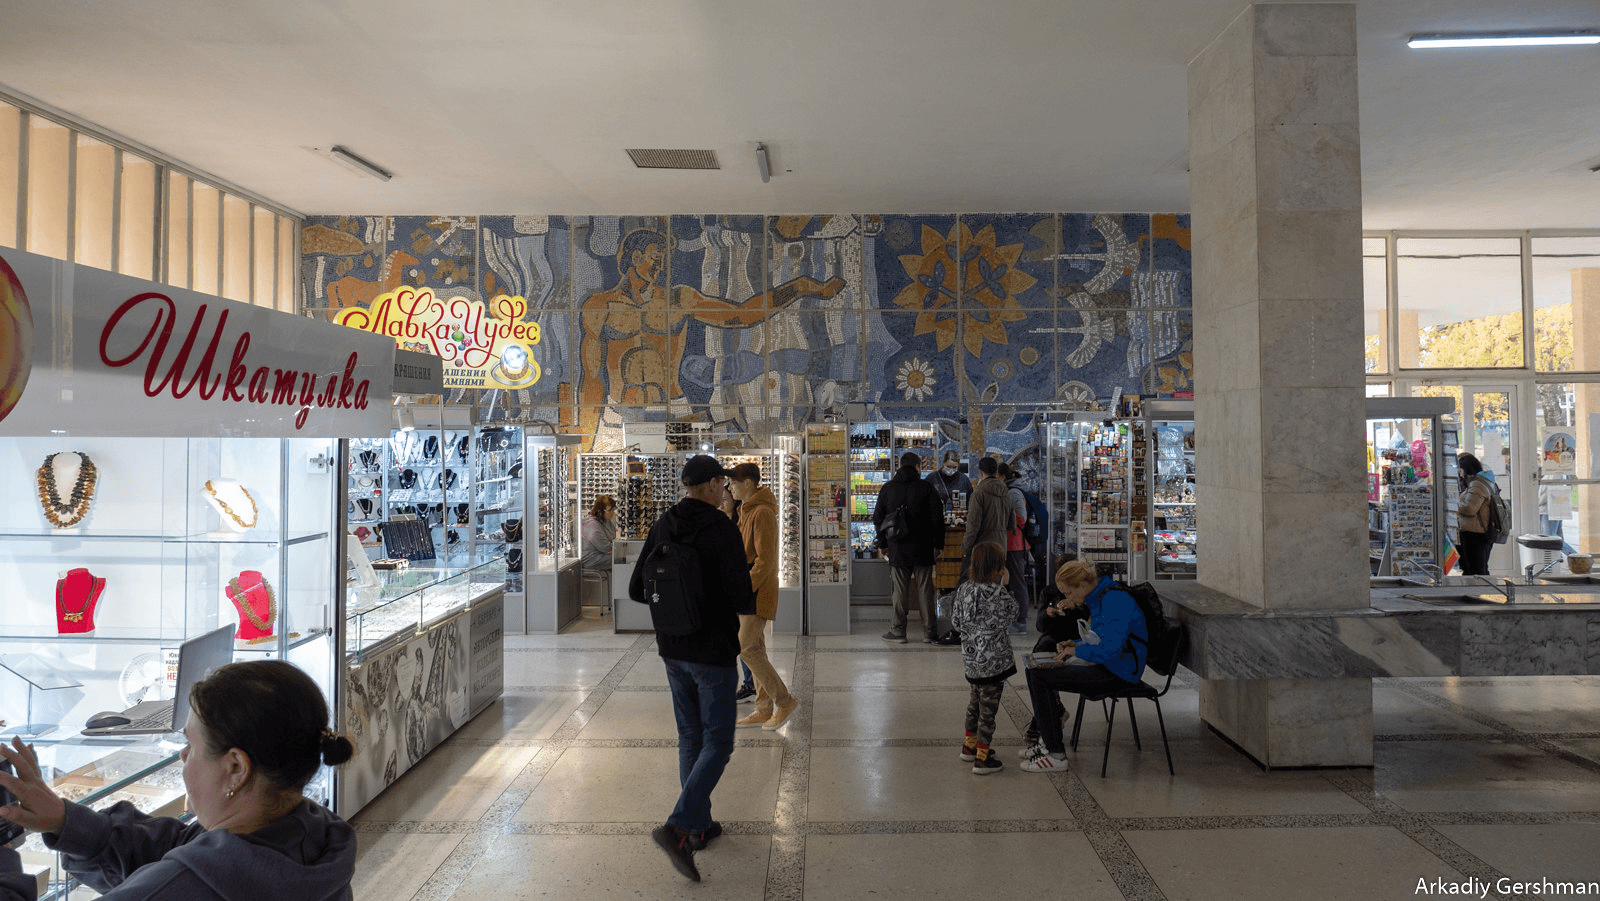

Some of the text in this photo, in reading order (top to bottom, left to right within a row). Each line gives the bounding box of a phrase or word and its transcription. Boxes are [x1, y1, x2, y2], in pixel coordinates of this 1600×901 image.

[343, 290, 537, 368] Лавка Чудес
[99, 292, 370, 429] Шкатулка
[394, 363, 431, 380] КРАШЕНИЯ
[443, 368, 487, 378] АШЕНИЯ
[443, 378, 486, 387] АМНЯМИ
